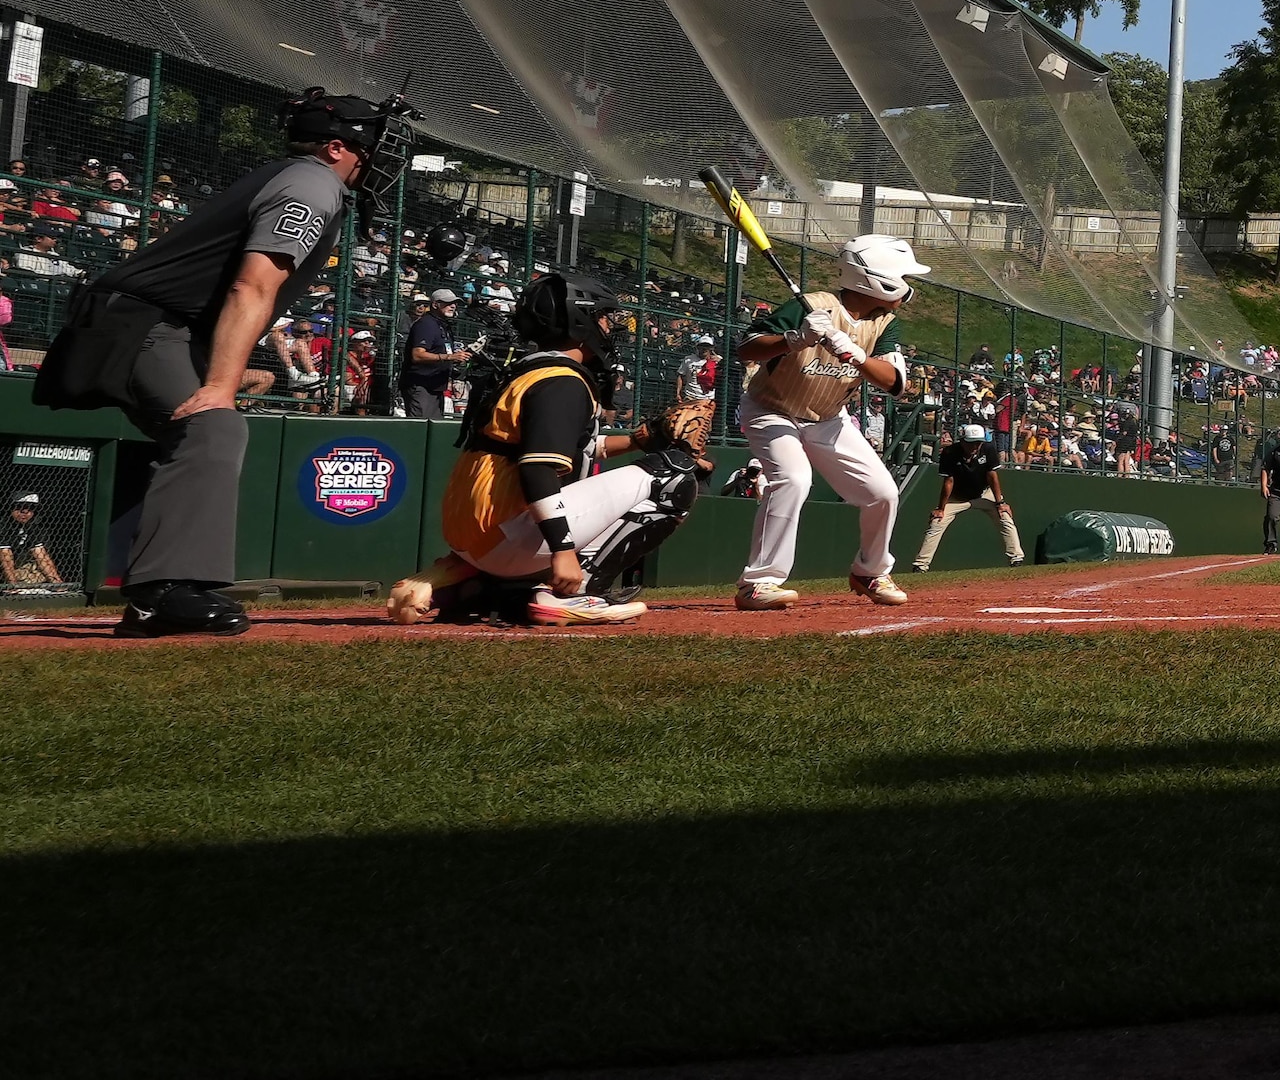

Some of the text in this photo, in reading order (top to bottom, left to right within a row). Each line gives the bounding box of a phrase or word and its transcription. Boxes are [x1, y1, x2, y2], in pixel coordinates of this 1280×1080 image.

[272, 201, 325, 252] 22
[317, 461, 391, 475] WORLD
[319, 475, 387, 489] SERIES
[343, 499, 369, 507] Mobile
